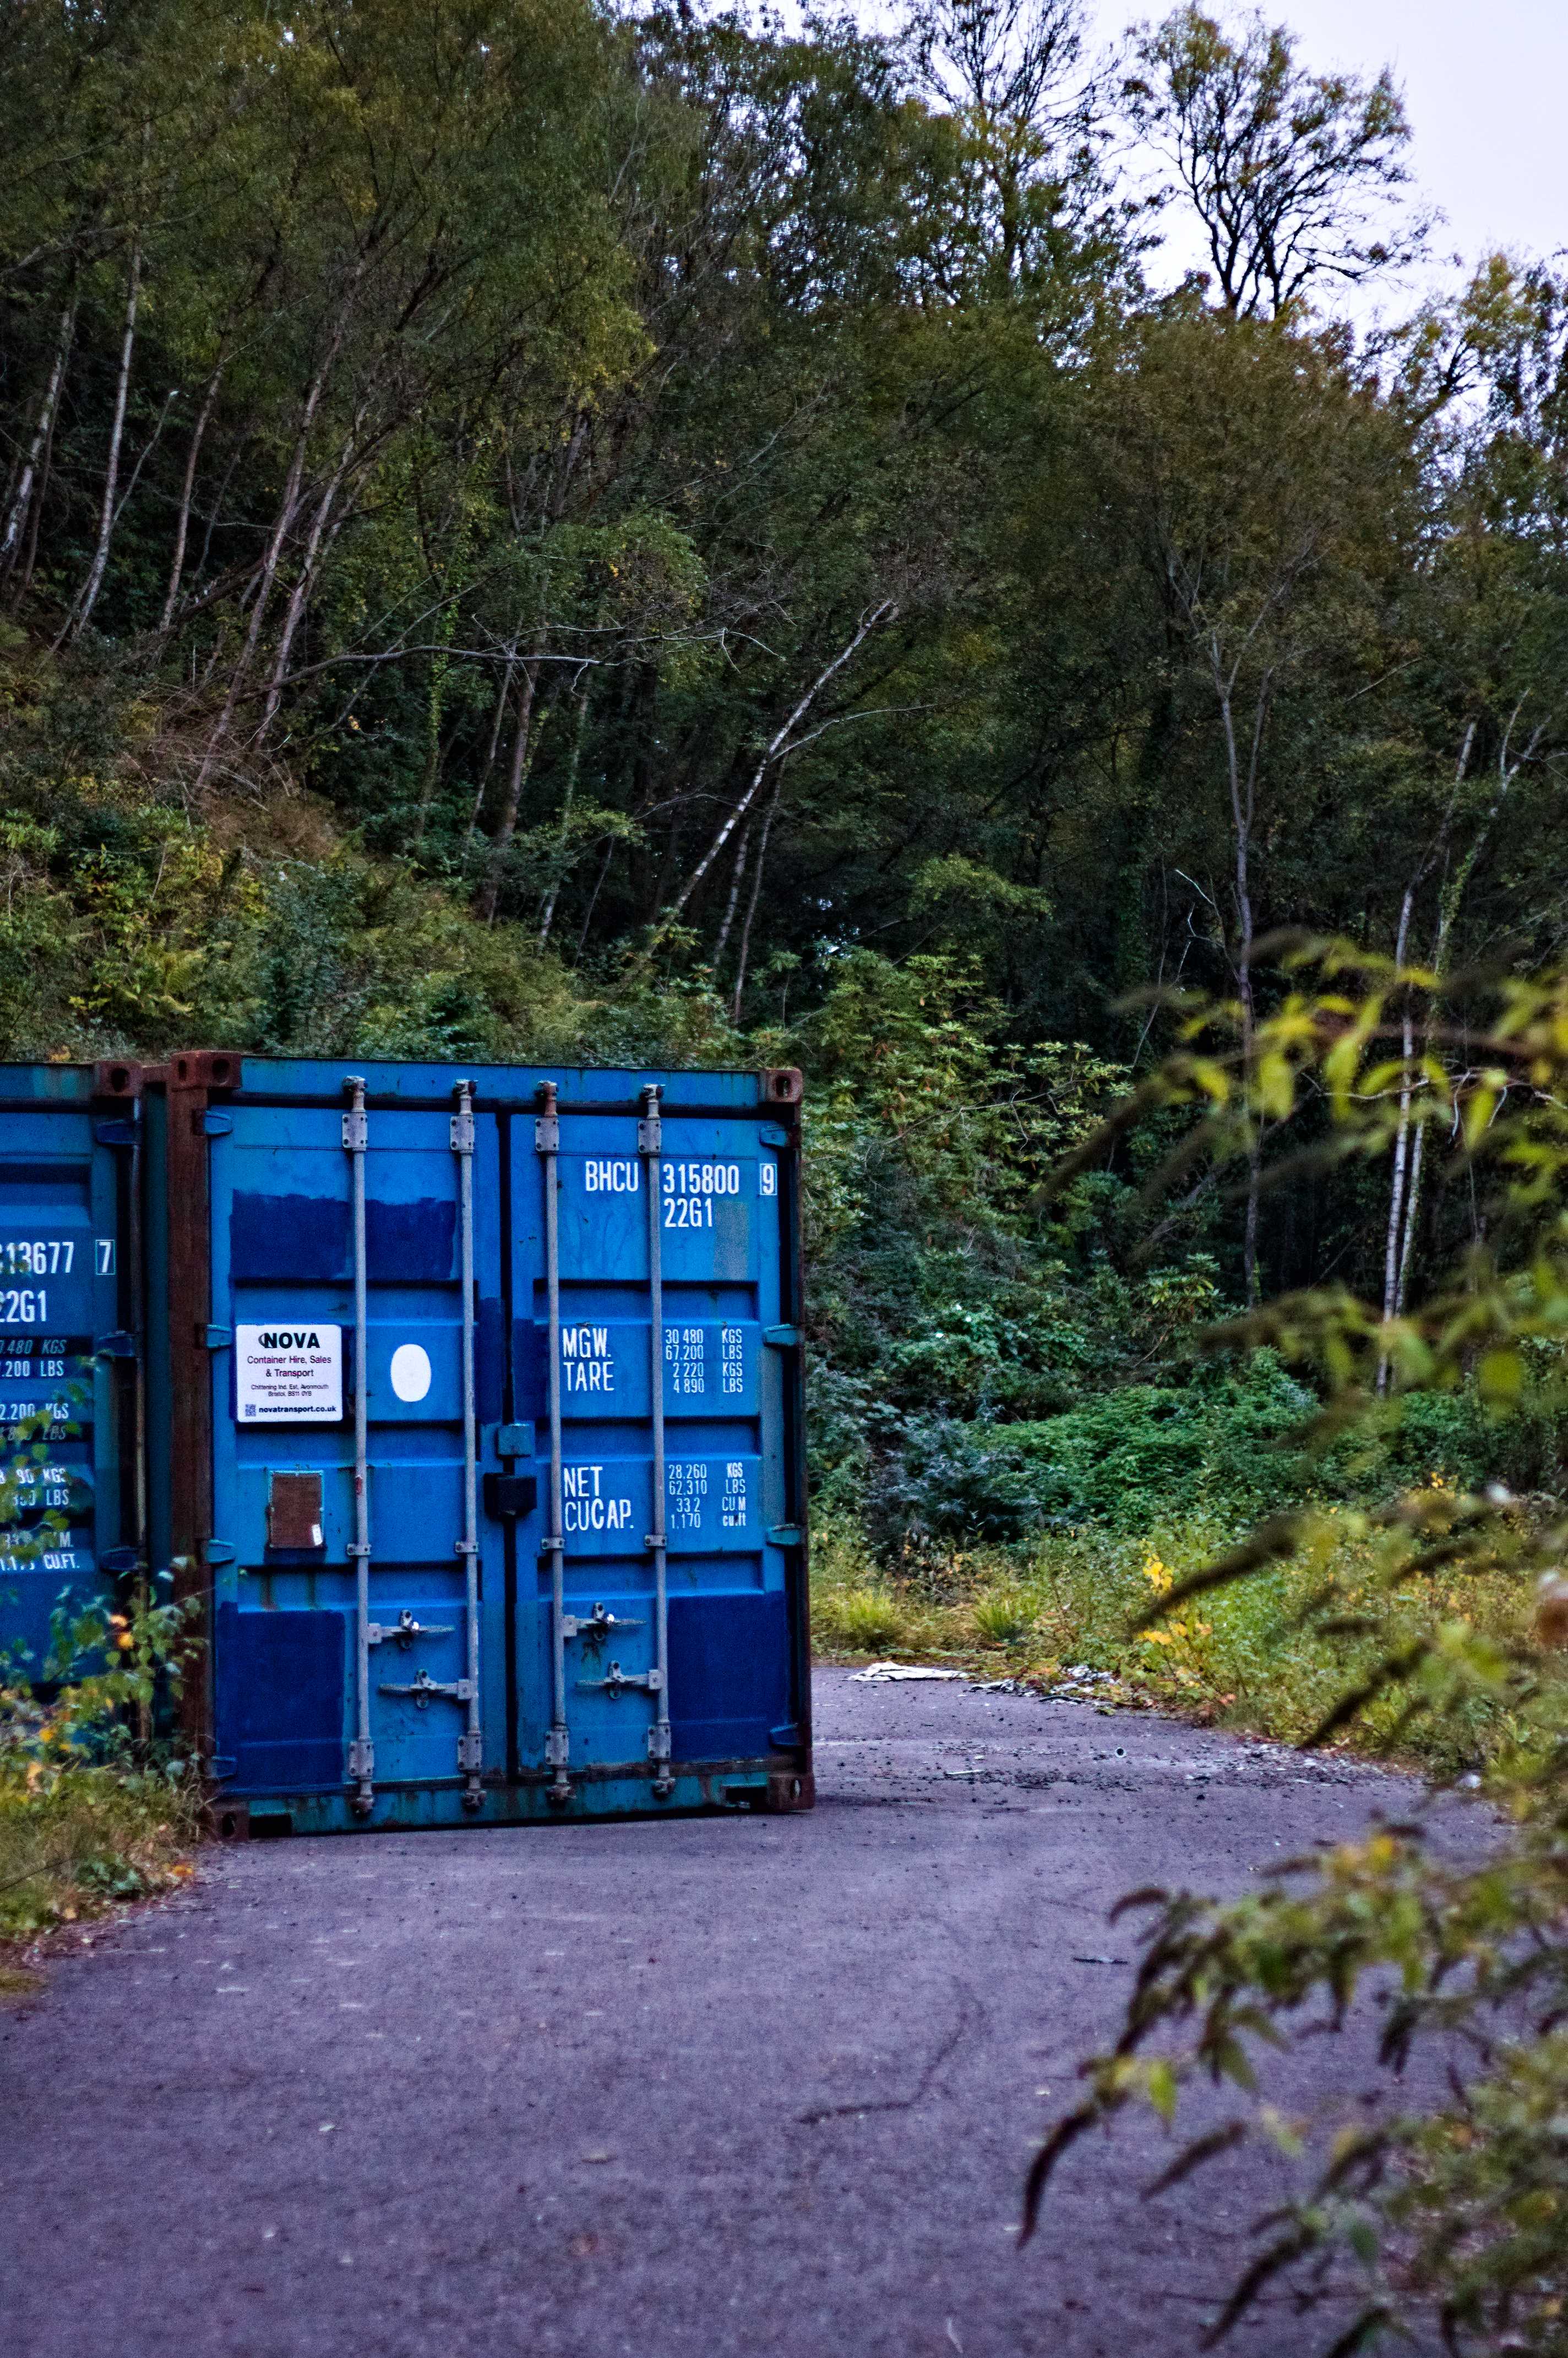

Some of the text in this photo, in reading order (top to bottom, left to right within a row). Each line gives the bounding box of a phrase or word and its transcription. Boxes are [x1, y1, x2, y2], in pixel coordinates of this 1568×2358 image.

[586, 1161, 774, 1194] BHCU 315800 9
[664, 1198, 713, 1227] 22G1
[0, 1241, 111, 1274] 13677 7
[260, 1333, 320, 1349] NOVA
[563, 1328, 611, 1357] MGW.
[722, 1328, 742, 1344] KGS
[41, 1339, 67, 1354] KGS
[666, 1345, 742, 1360] 67.200 LBS
[247, 1355, 331, 1364] Container Hire, Sales
[0, 1360, 64, 1377] .200 LBS
[266, 1368, 314, 1378] & Transport
[563, 1361, 614, 1392] TARE
[722, 1362, 743, 1377] KGS
[723, 1378, 743, 1393] LBS
[259, 1405, 336, 1414] novatransport.co.uk
[668, 1462, 743, 1479] 28.260 KGS
[564, 1466, 603, 1497] NET
[669, 1479, 745, 1495] 62.310 LBS
[46, 1489, 70, 1506] LBS
